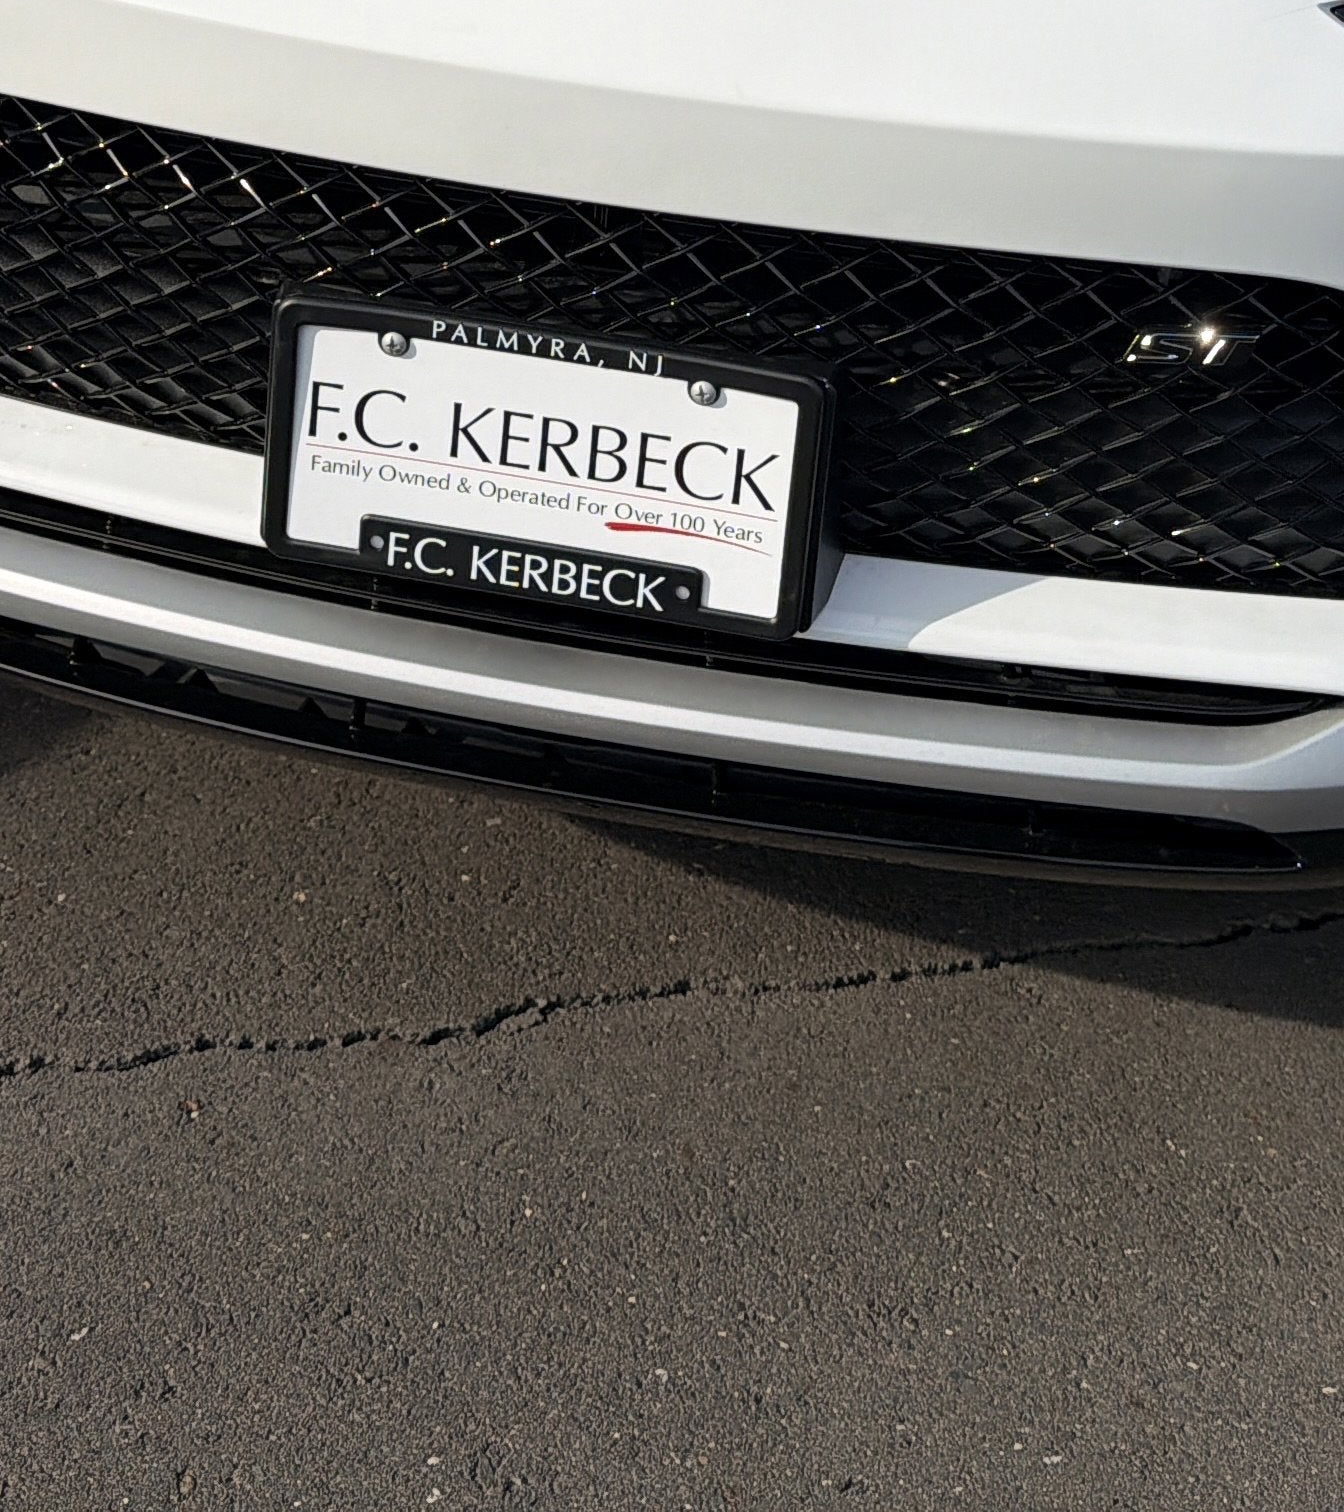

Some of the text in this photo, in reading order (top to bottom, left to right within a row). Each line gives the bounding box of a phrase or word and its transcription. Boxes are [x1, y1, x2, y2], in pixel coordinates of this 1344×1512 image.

[431, 319, 664, 378] PALMYRA, NJ
[1122, 330, 1261, 367] ST
[308, 380, 781, 513] F.C. KERBECK
[311, 454, 764, 544] Family Owned & Operated For Over 100 Years
[386, 530, 667, 613] F.C. KERBECK
